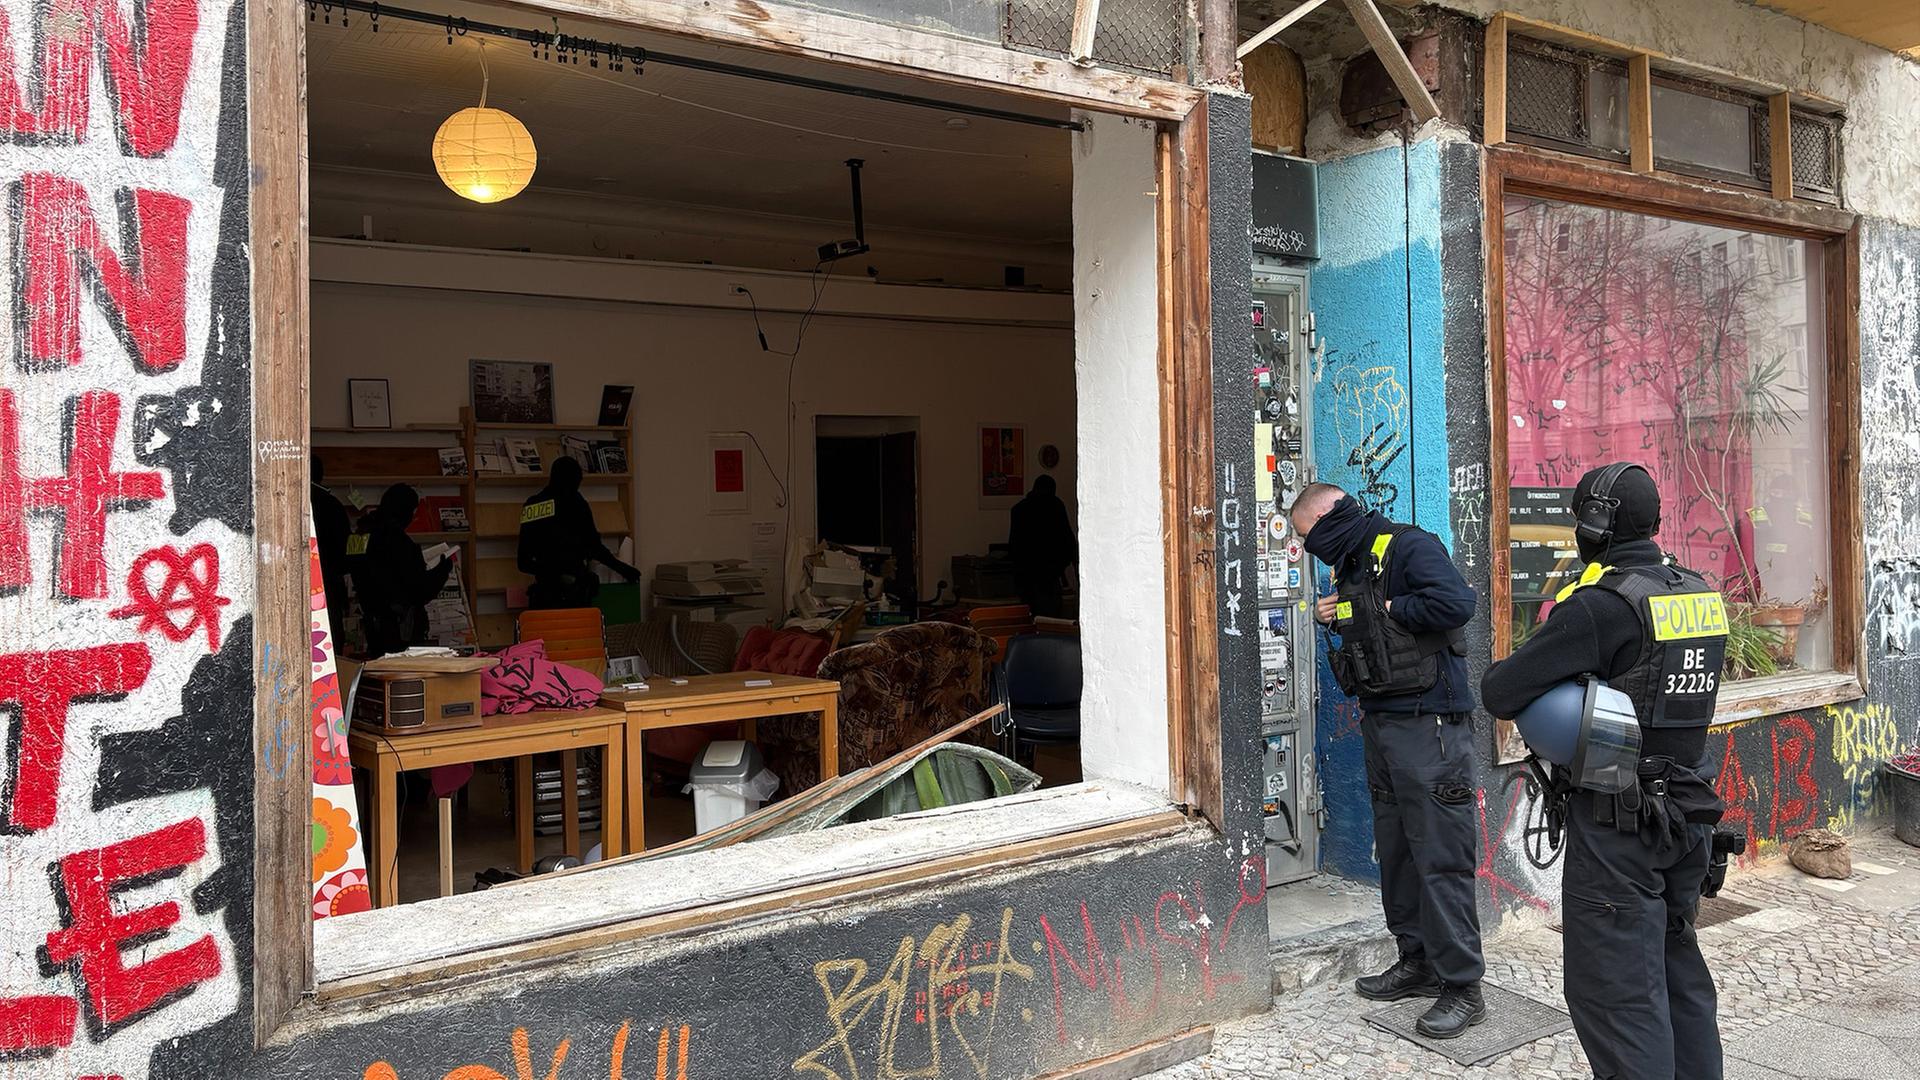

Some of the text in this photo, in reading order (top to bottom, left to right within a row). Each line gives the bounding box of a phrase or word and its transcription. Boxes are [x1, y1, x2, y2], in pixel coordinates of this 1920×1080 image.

[521, 502, 553, 521] POLIZEI
[1653, 597, 1727, 635] POLIZEI
[1683, 648, 1705, 670] BE
[1665, 672, 1714, 694] 32226
